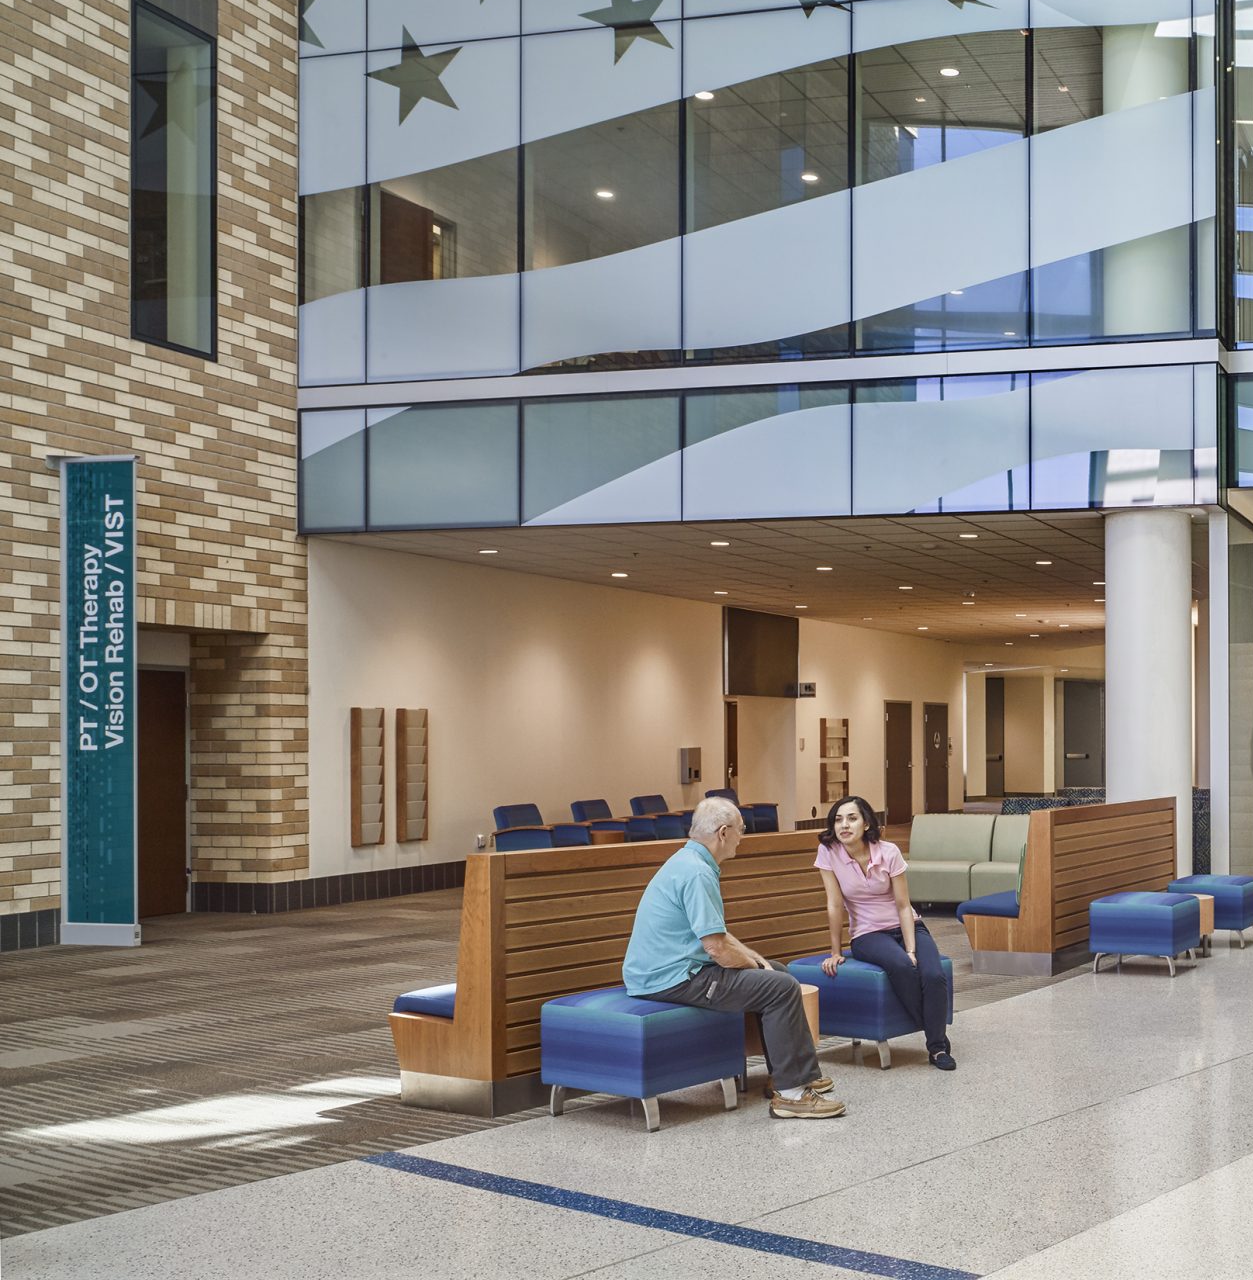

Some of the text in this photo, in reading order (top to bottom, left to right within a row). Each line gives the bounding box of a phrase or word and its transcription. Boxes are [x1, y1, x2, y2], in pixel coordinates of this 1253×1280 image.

[80, 544, 103, 751] PT / OT Therapy
[105, 494, 124, 749] Vision Rehab / VIST
